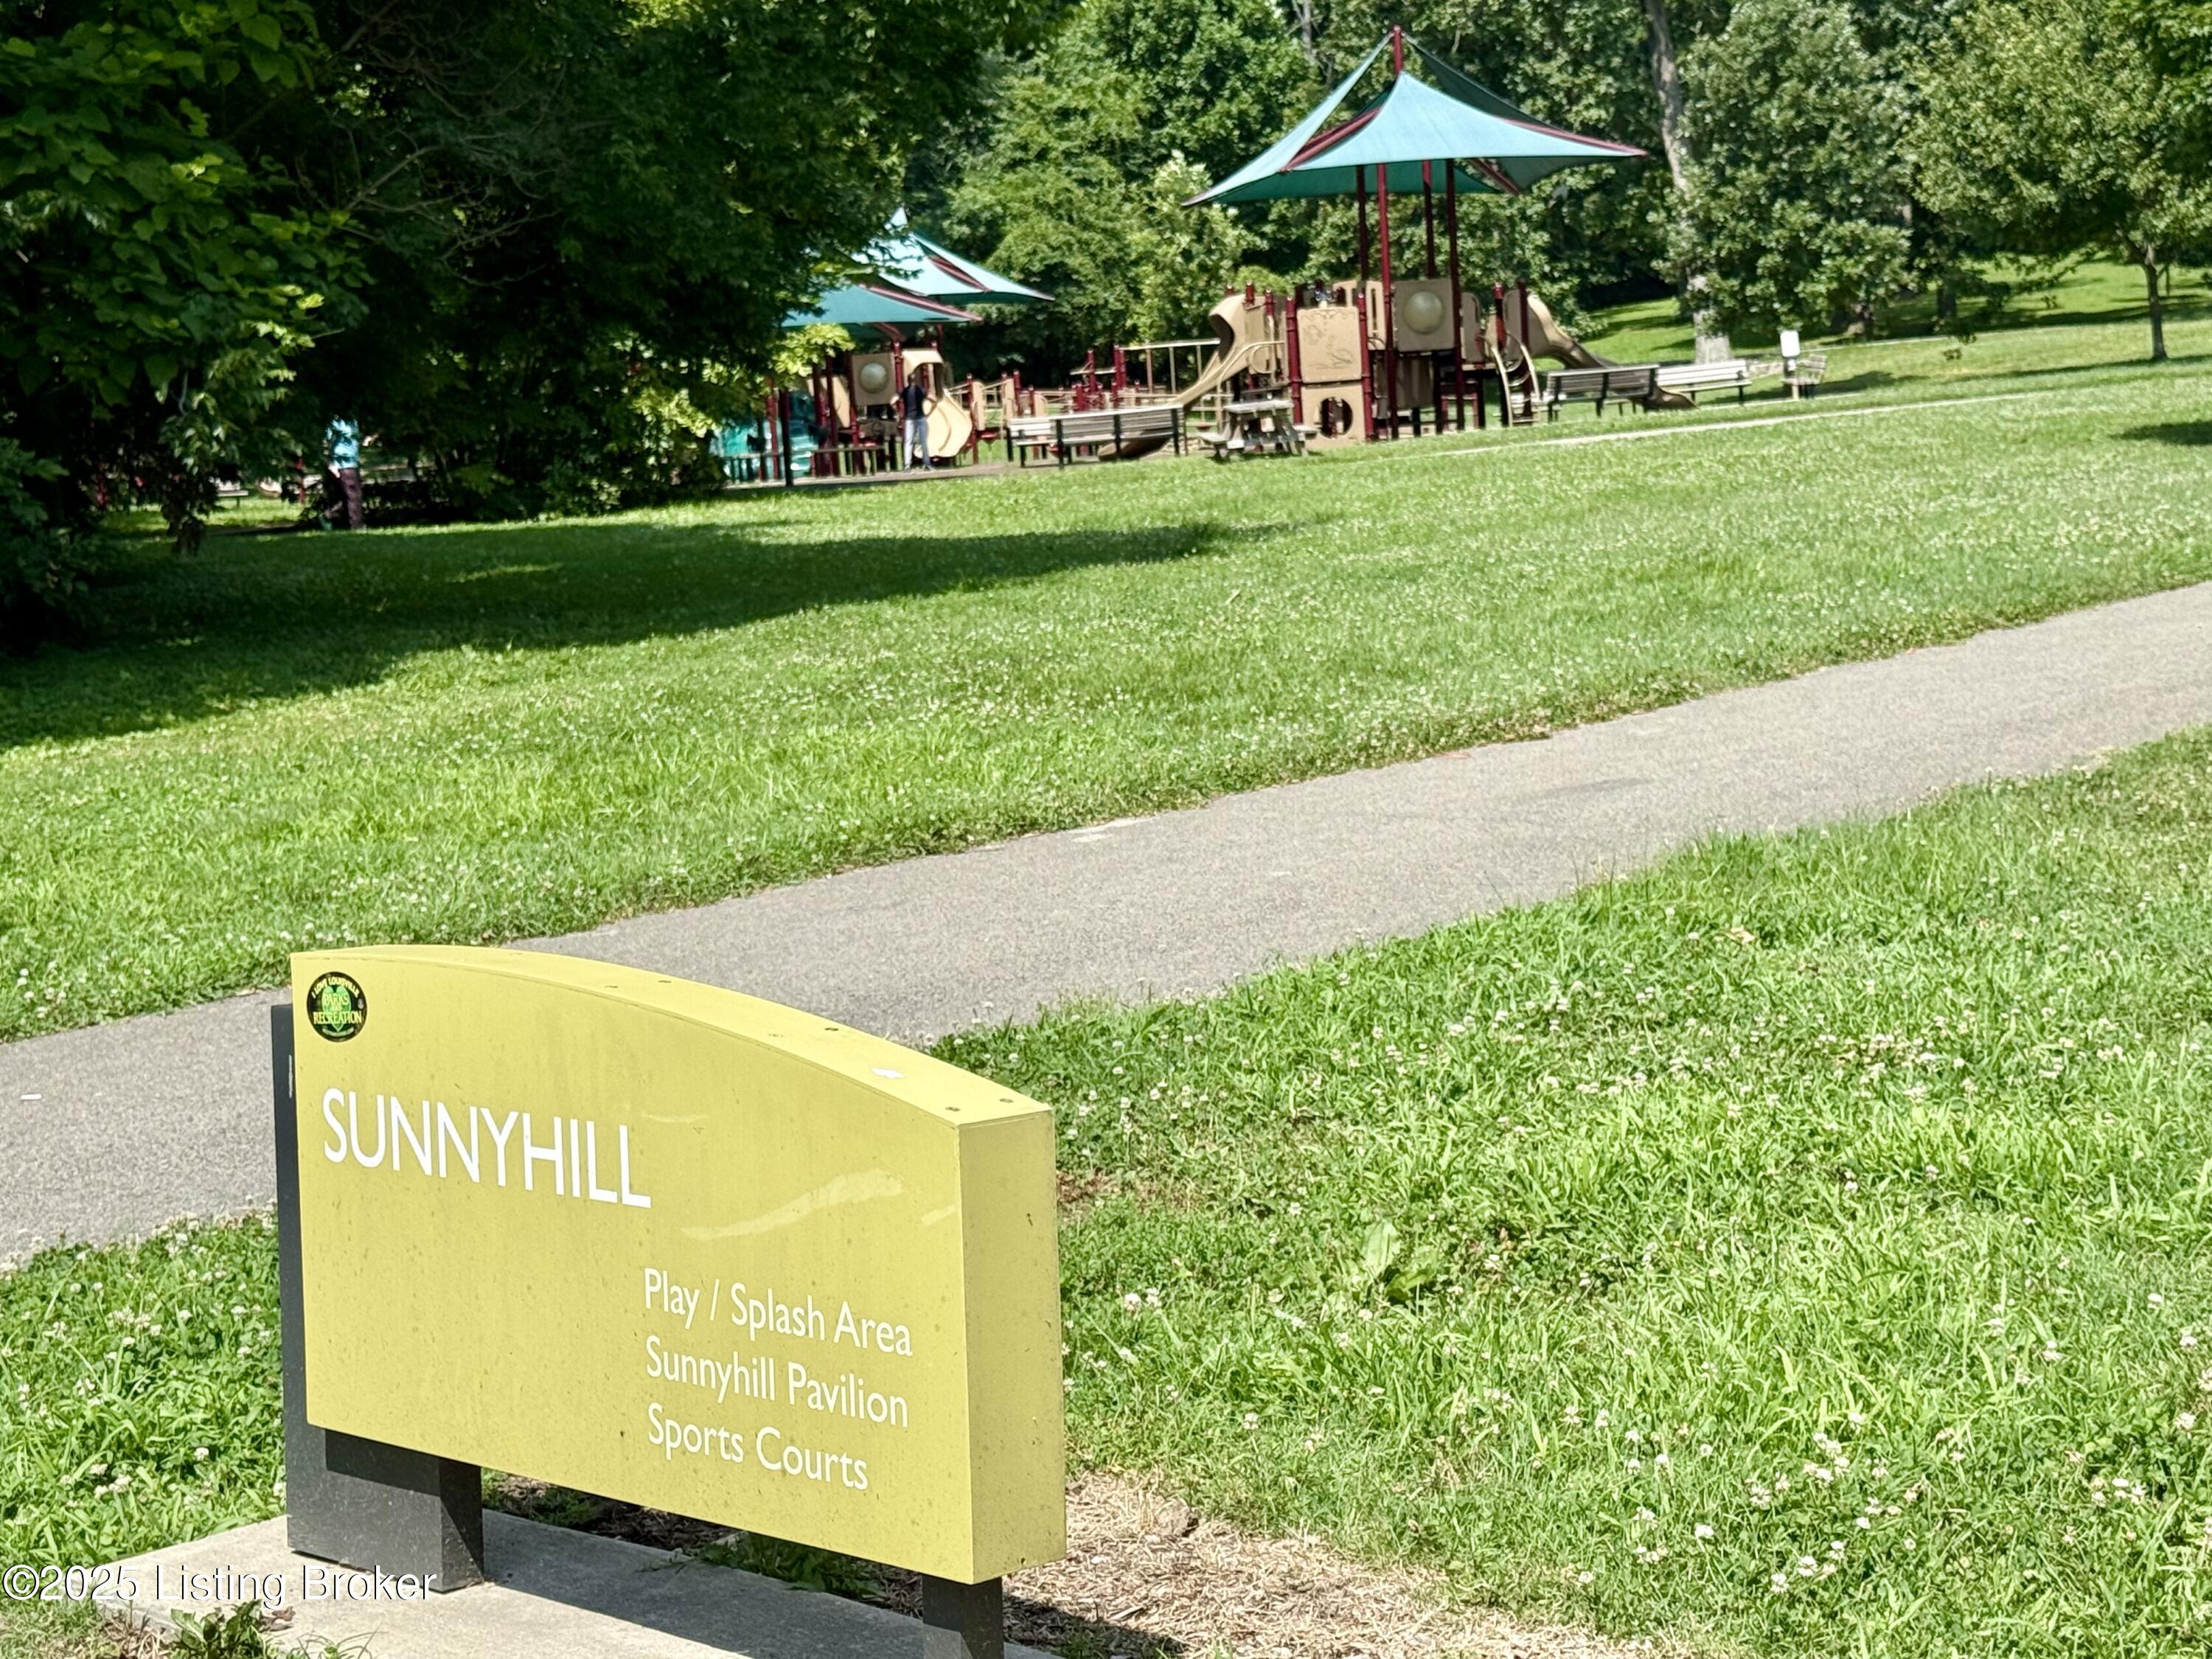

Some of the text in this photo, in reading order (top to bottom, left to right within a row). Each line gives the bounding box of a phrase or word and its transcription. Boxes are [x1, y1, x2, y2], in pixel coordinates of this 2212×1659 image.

[313, 1011, 362, 1024] RECREATION
[324, 992, 348, 1006] PARKS
[322, 1088, 652, 1209] SUNNYHILL
[644, 1267, 914, 1357] Play / Splash Area
[646, 1335, 908, 1428] Sunnyhill Pavilion
[648, 1402, 869, 1490] Sports Courts
